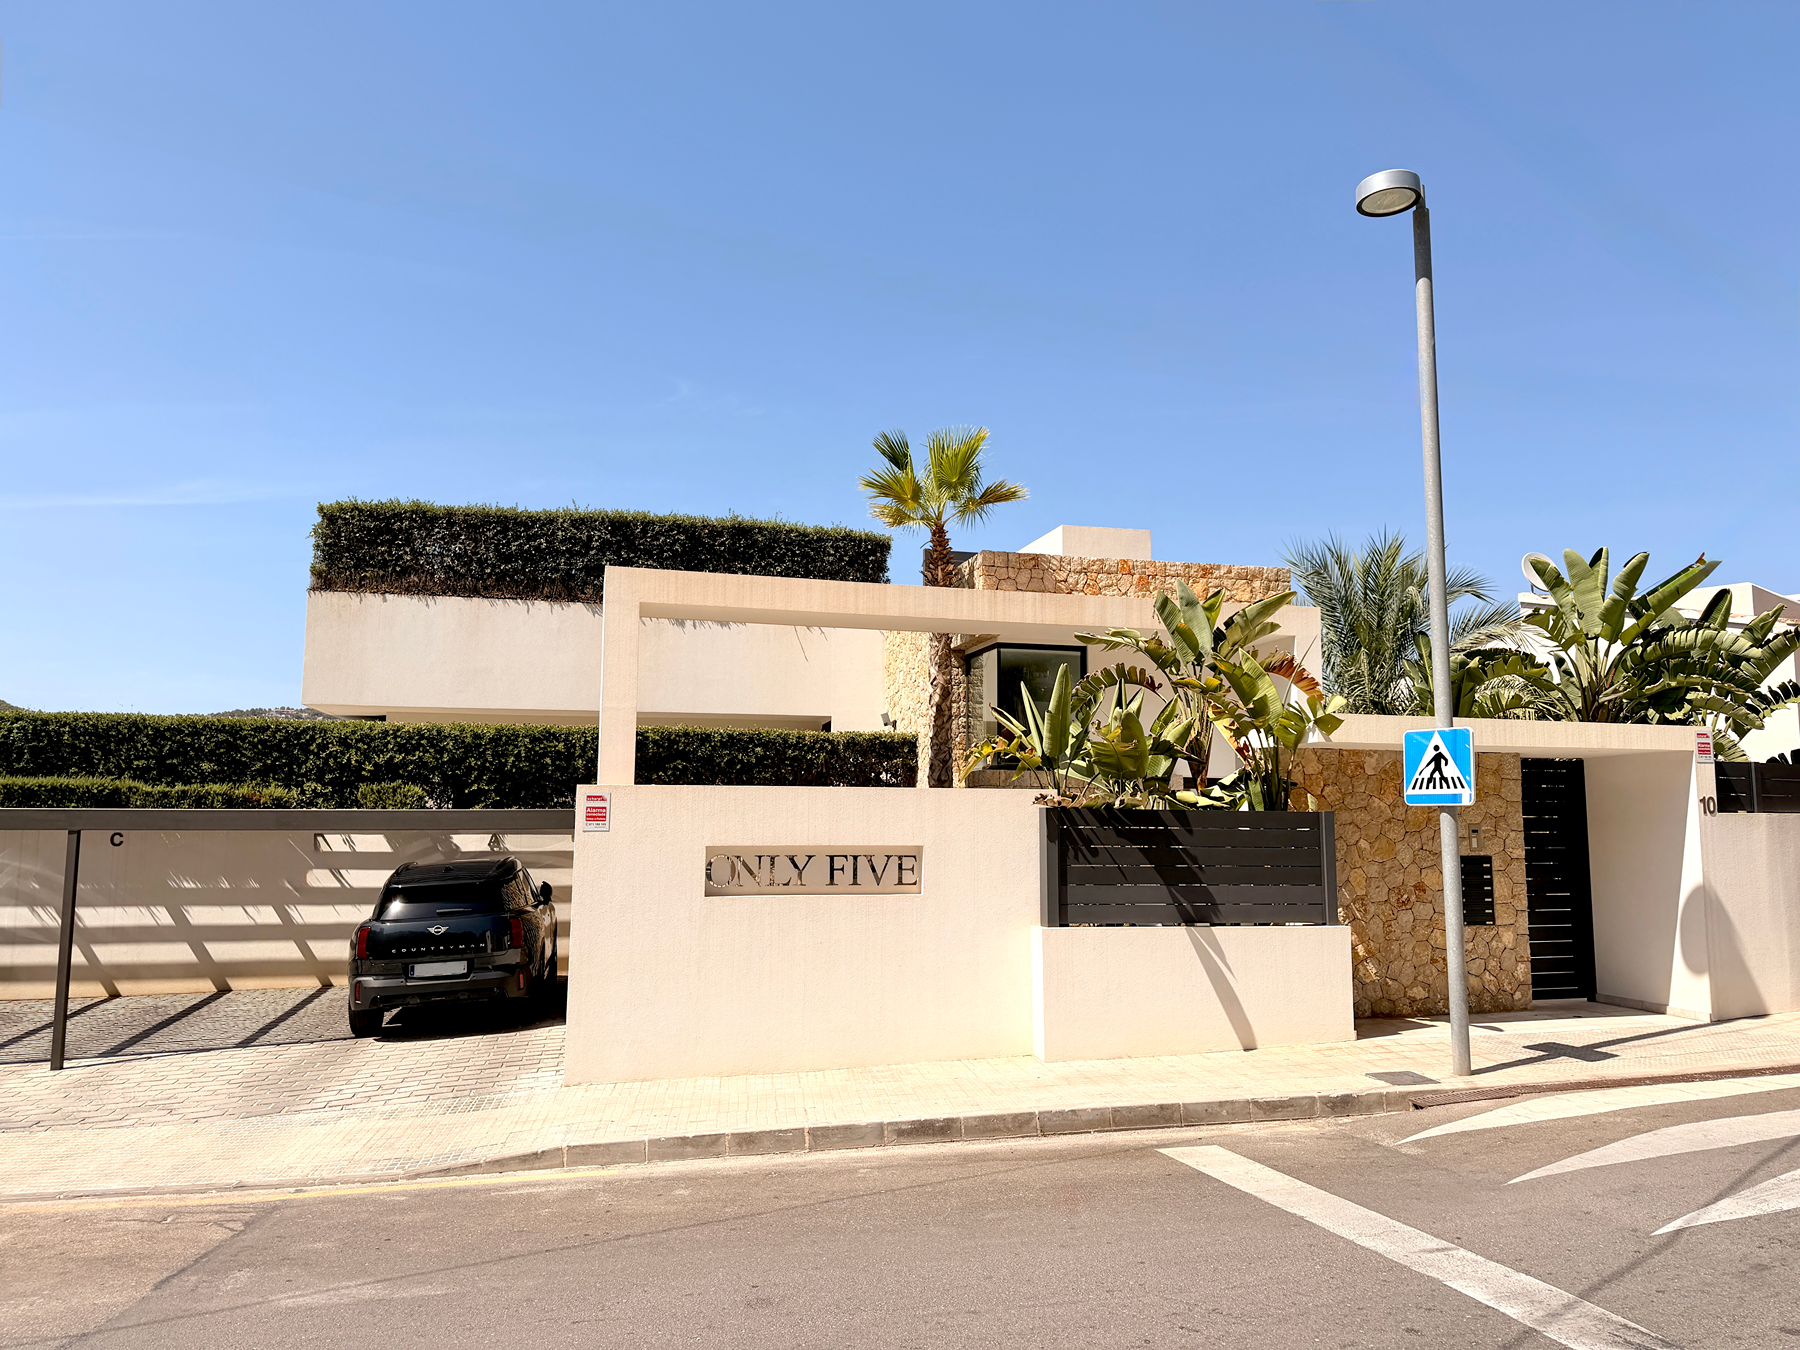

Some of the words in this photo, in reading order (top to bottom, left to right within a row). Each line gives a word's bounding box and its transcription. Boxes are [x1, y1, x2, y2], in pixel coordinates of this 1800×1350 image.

[1700, 796, 1716, 815] 10
[110, 832, 124, 847] C
[705, 854, 816, 888] ONLY
[825, 854, 919, 887] FIVE
[391, 943, 485, 954] COUNTRYMAN
